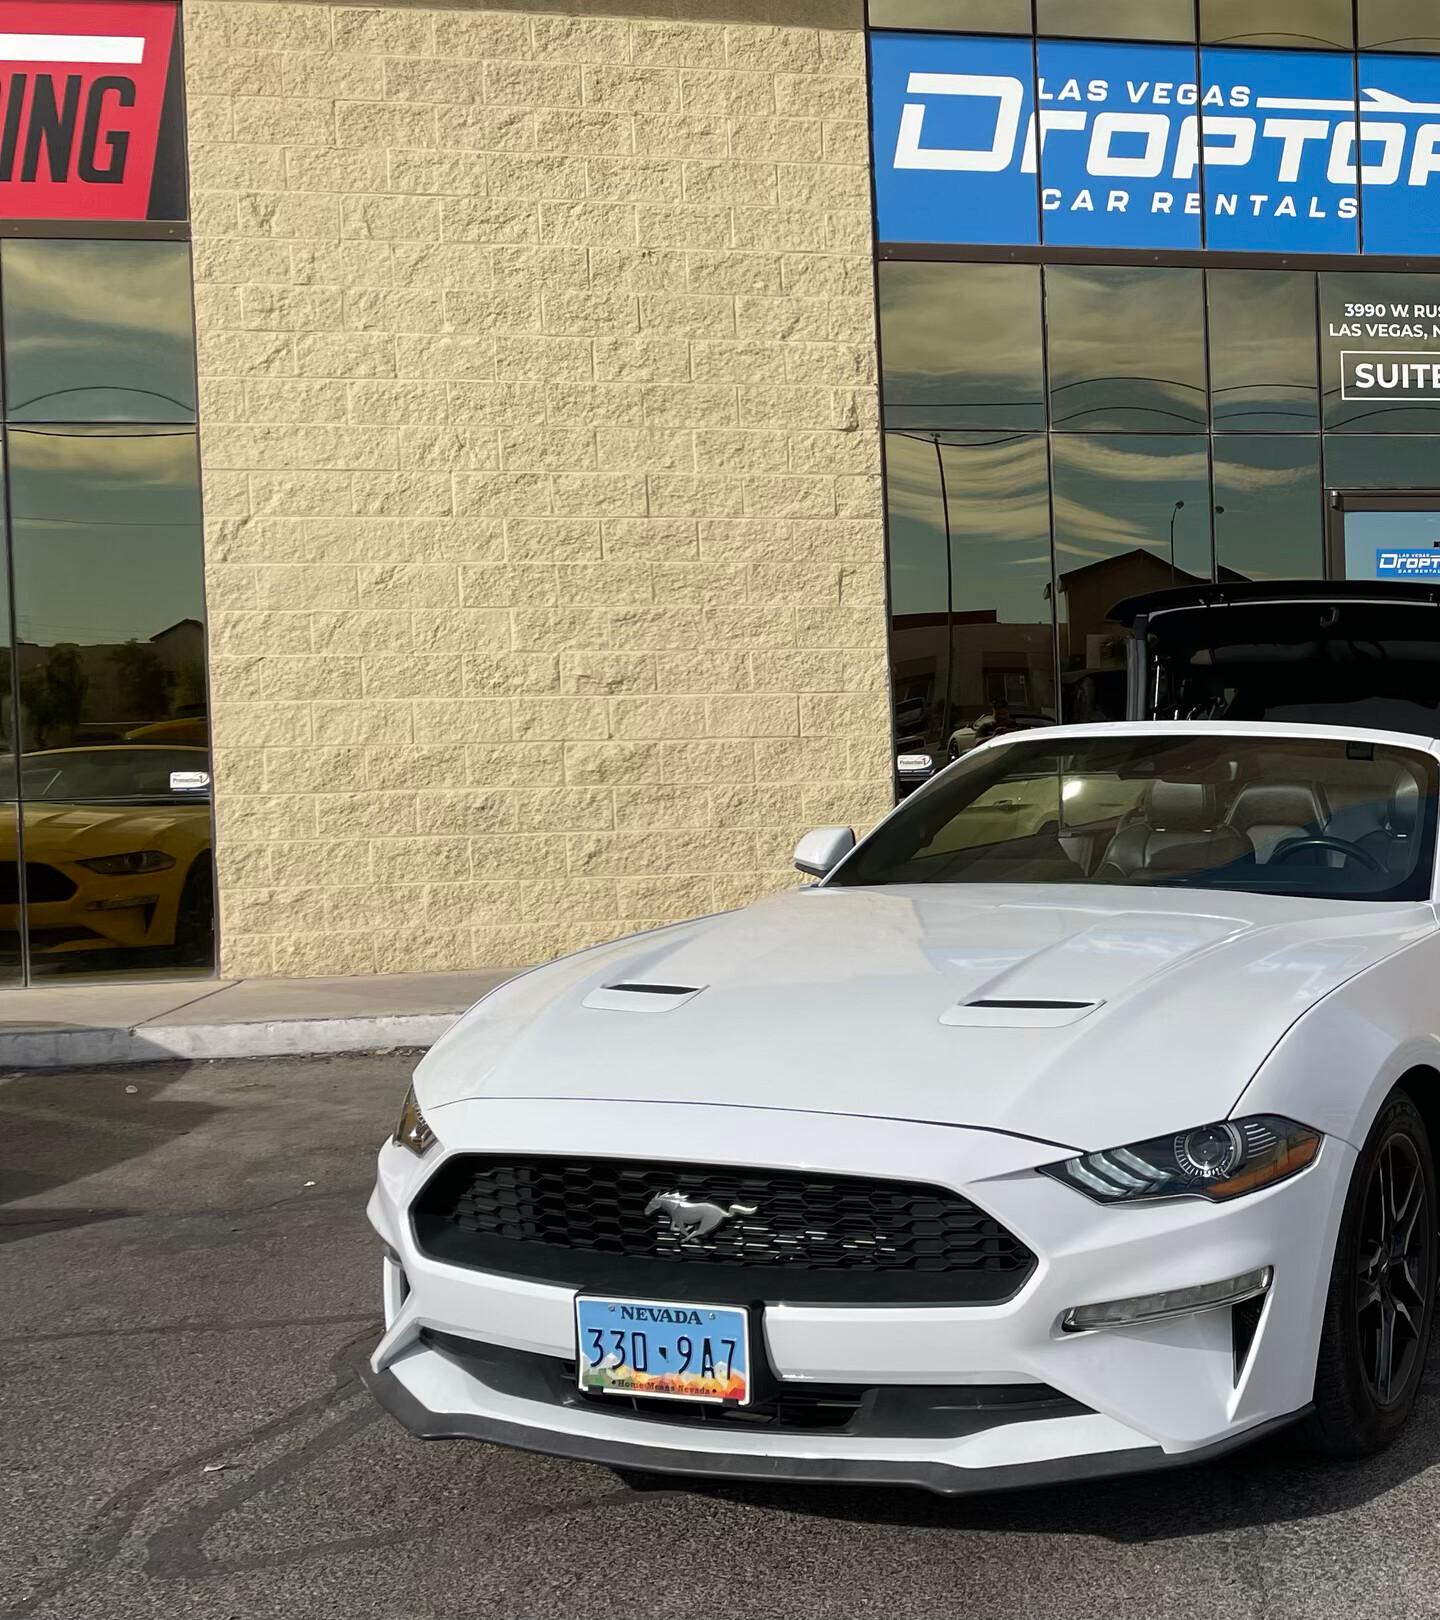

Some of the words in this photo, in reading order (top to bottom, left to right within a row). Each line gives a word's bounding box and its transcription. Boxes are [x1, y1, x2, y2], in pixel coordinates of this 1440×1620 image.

[1038, 78, 1110, 102] LAS
[1125, 81, 1252, 108] VEGAS
[0, 73, 136, 184] ING
[1041, 188, 1127, 213] CAR
[1152, 191, 1359, 219] RENTALS
[1344, 303, 1386, 318] 3990
[1329, 323, 1361, 337] LAS
[1365, 323, 1428, 340] VEGAS,
[621, 1306, 703, 1325] NEVADA
[677, 1336, 736, 1381] 9A7
[618, 1380, 646, 1390] Home
[648, 1382, 675, 1392] Means
[677, 1384, 711, 1395] Nevada
